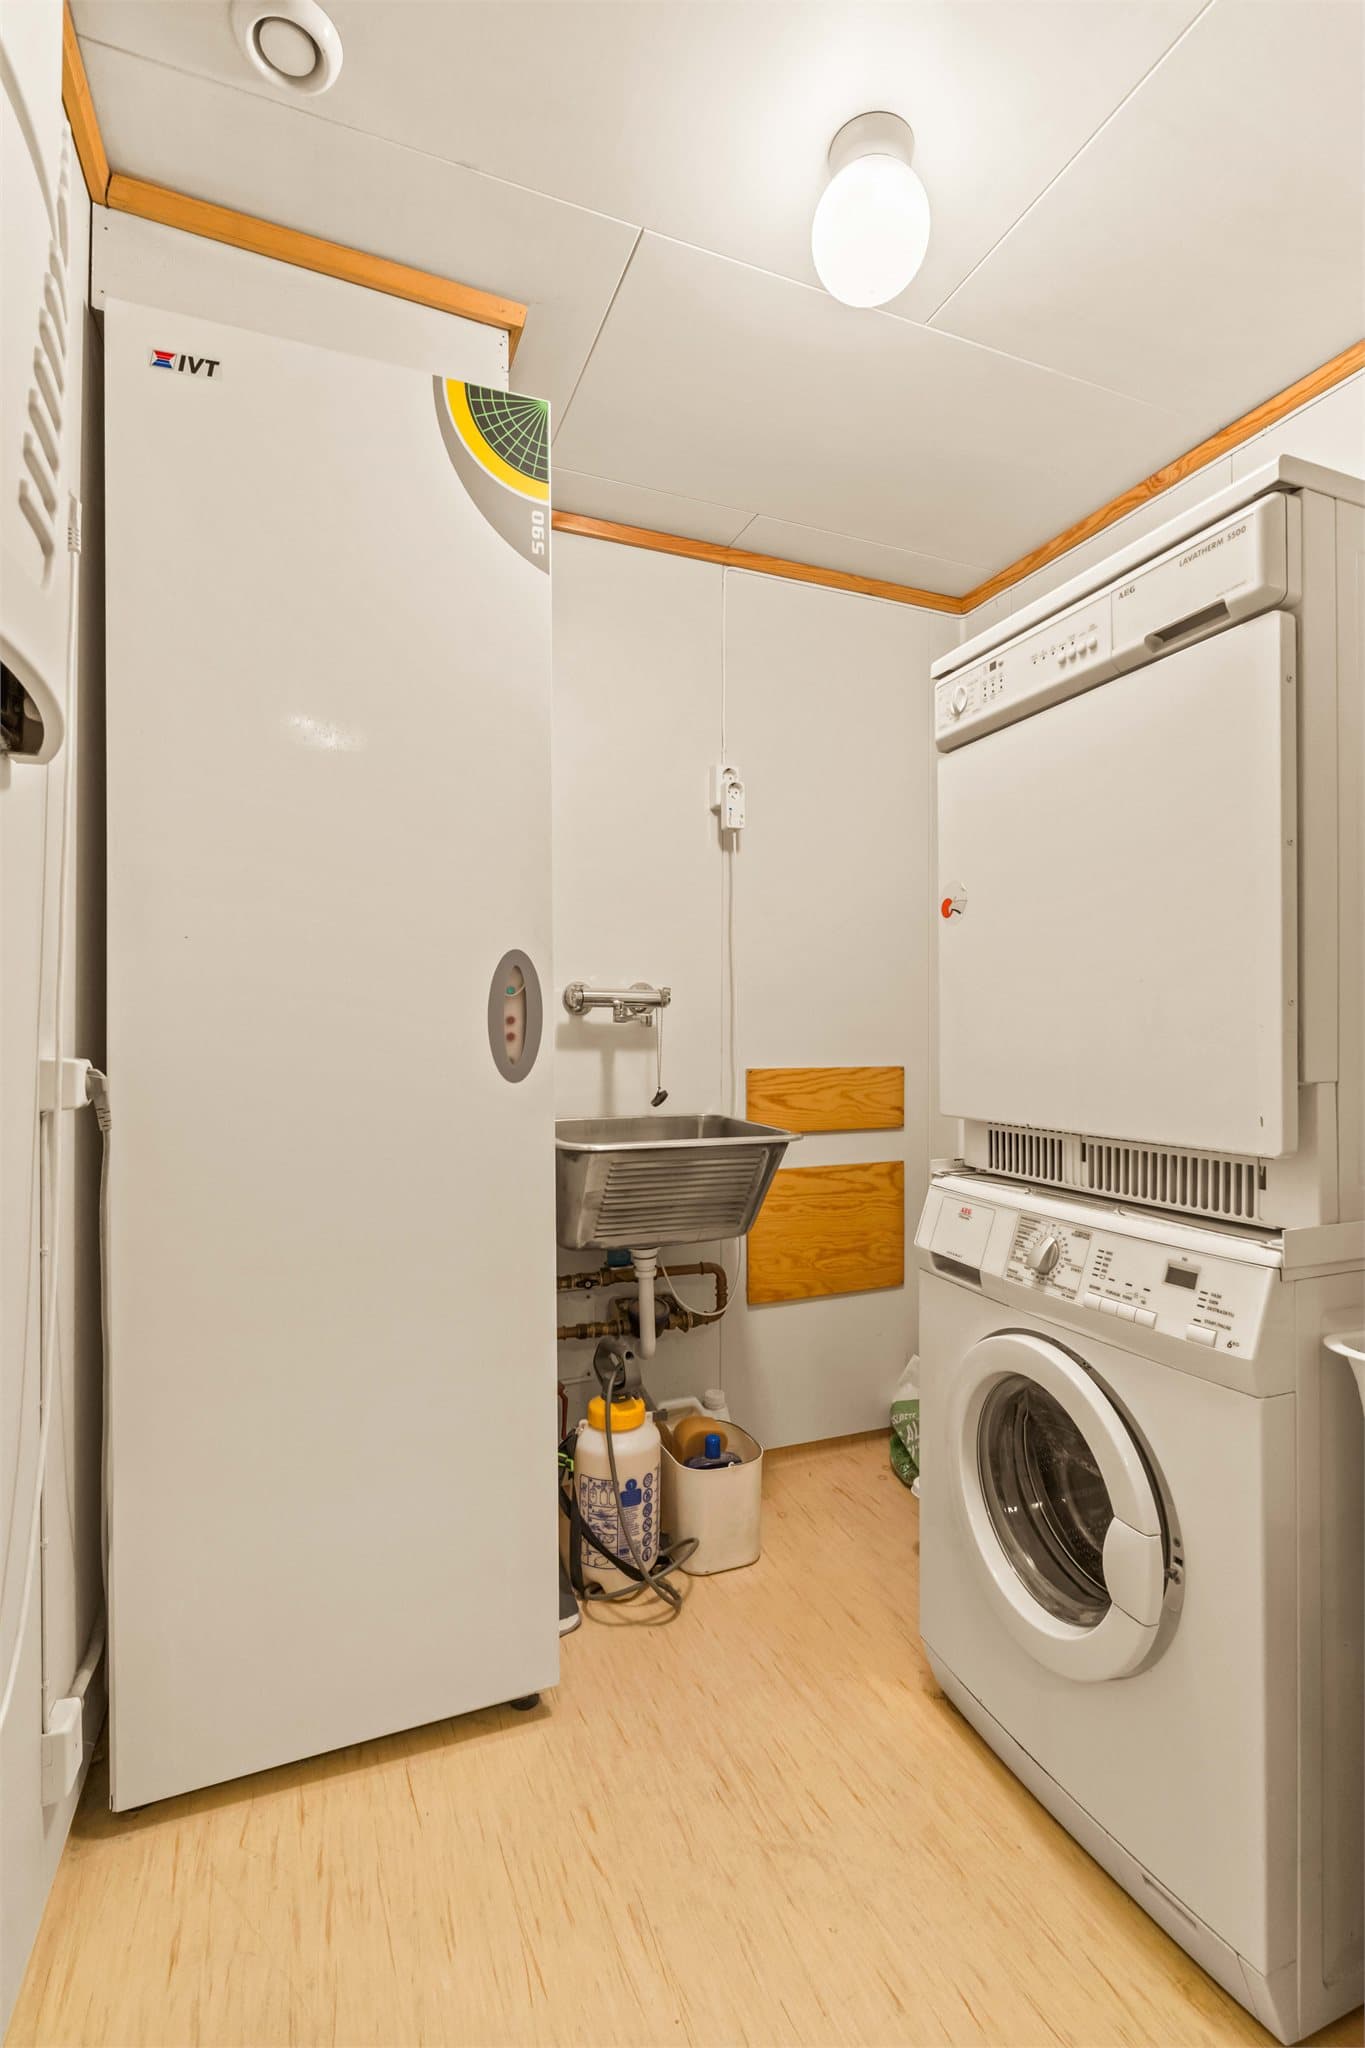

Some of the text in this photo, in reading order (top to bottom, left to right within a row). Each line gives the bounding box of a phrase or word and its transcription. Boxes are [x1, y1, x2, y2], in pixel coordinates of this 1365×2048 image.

[178, 354, 220, 377] IVT
[531, 510, 545, 555] 590
[1178, 536, 1224, 568] LAVATHERM
[1118, 585, 1136, 600] AEG
